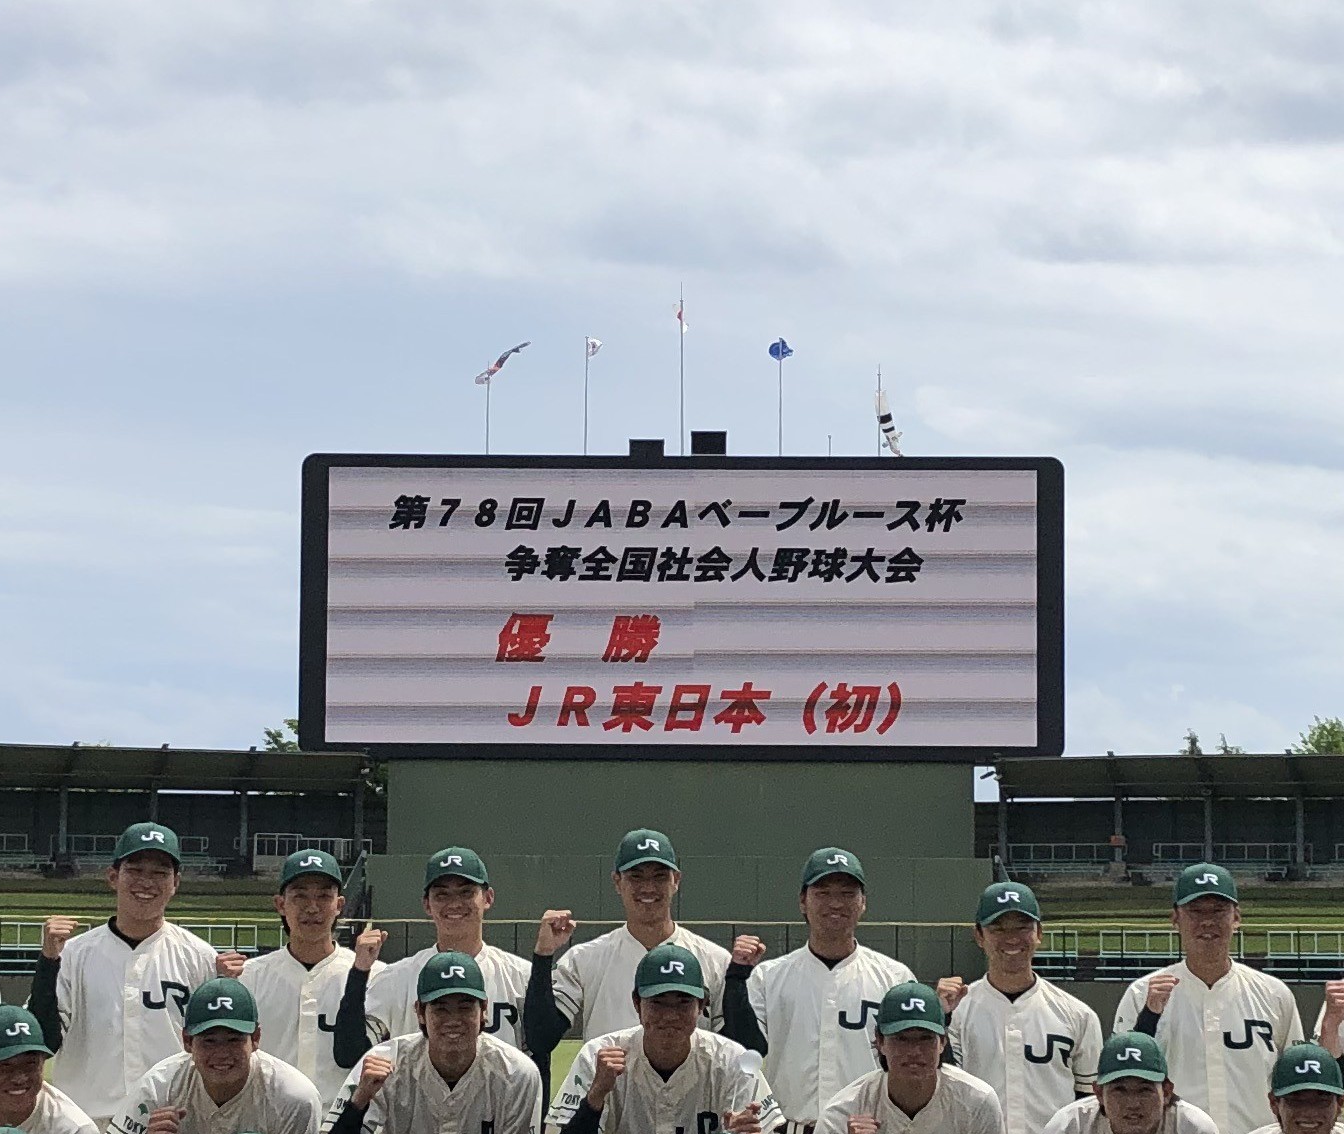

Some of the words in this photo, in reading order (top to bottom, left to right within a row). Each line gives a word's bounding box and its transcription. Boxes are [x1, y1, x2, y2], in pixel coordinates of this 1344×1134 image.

[505, 545, 924, 583] 争奪全国社会人野球大会
[141, 830, 165, 844] JR
[636, 838, 661, 852] JR
[299, 855, 324, 868] JR
[439, 854, 464, 868] JR
[826, 854, 849, 867] JR
[1195, 872, 1220, 886] JR
[996, 890, 1021, 903] JR
[440, 965, 466, 979] JR
[660, 960, 685, 975] JR
[142, 980, 190, 1017] JR
[207, 996, 234, 1010] JR
[901, 998, 926, 1012] JR
[5, 1022, 32, 1036] JR
[1223, 1019, 1274, 1052] JR
[1024, 1034, 1074, 1068] JR
[1116, 1047, 1142, 1062] JR
[1295, 1060, 1322, 1074] JR
